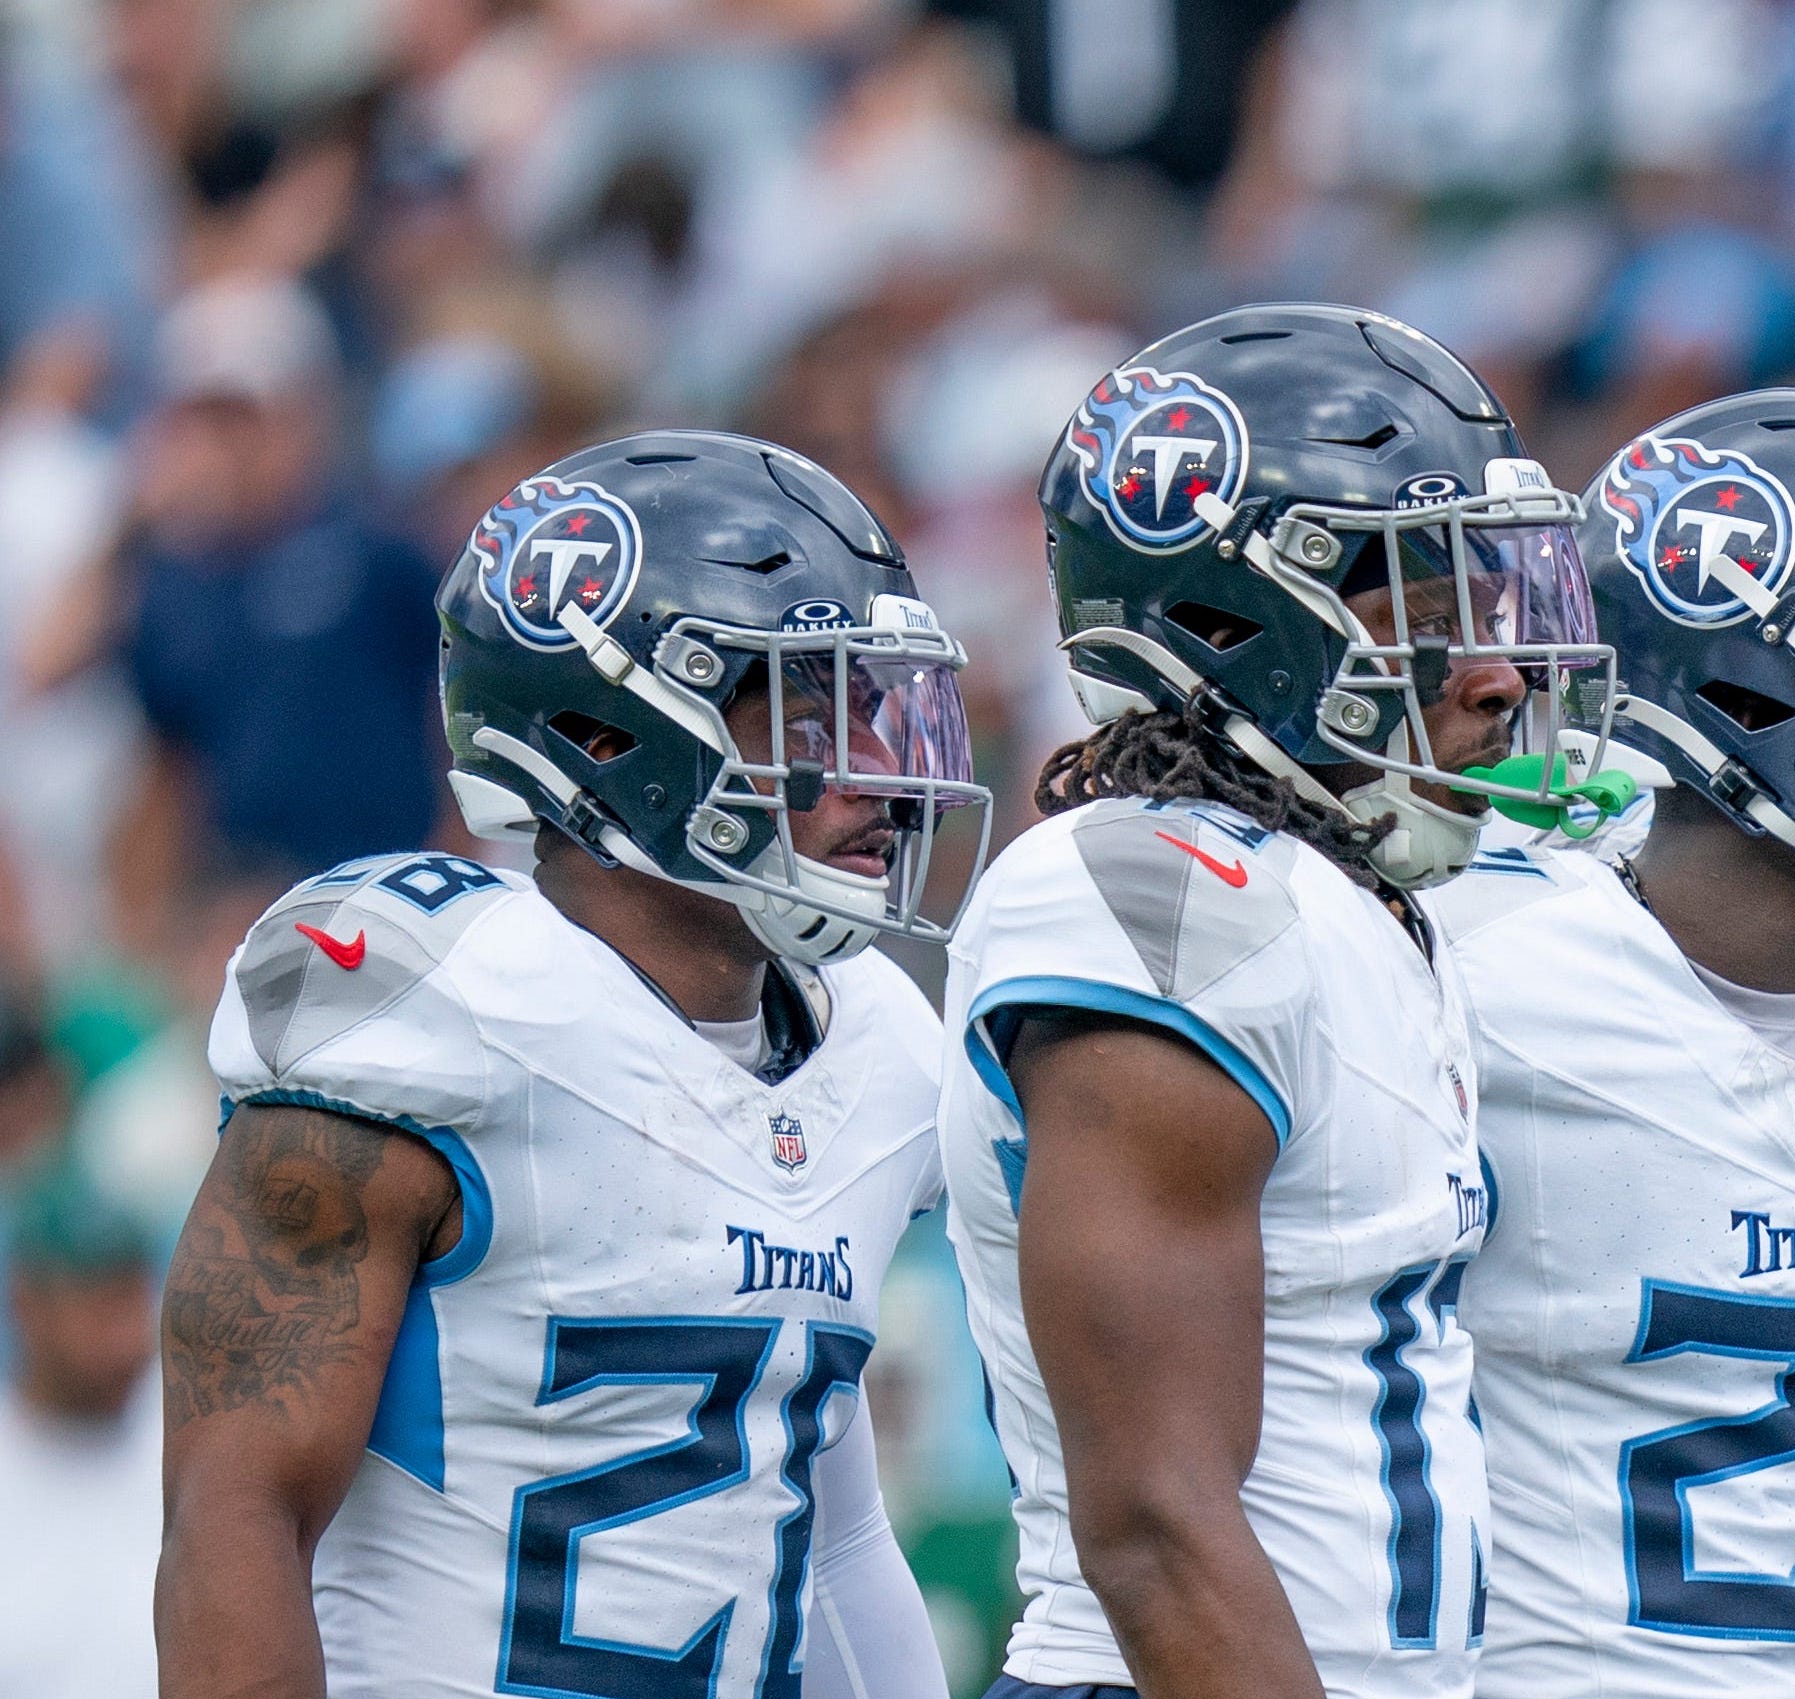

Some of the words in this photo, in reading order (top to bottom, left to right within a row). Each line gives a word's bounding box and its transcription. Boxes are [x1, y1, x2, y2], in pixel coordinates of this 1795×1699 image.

[1132, 436, 1218, 522] T
[530, 538, 612, 620] T
[1677, 508, 1769, 597] T
[776, 1136, 806, 1166] NFL
[726, 1224, 853, 1301] TITANS
